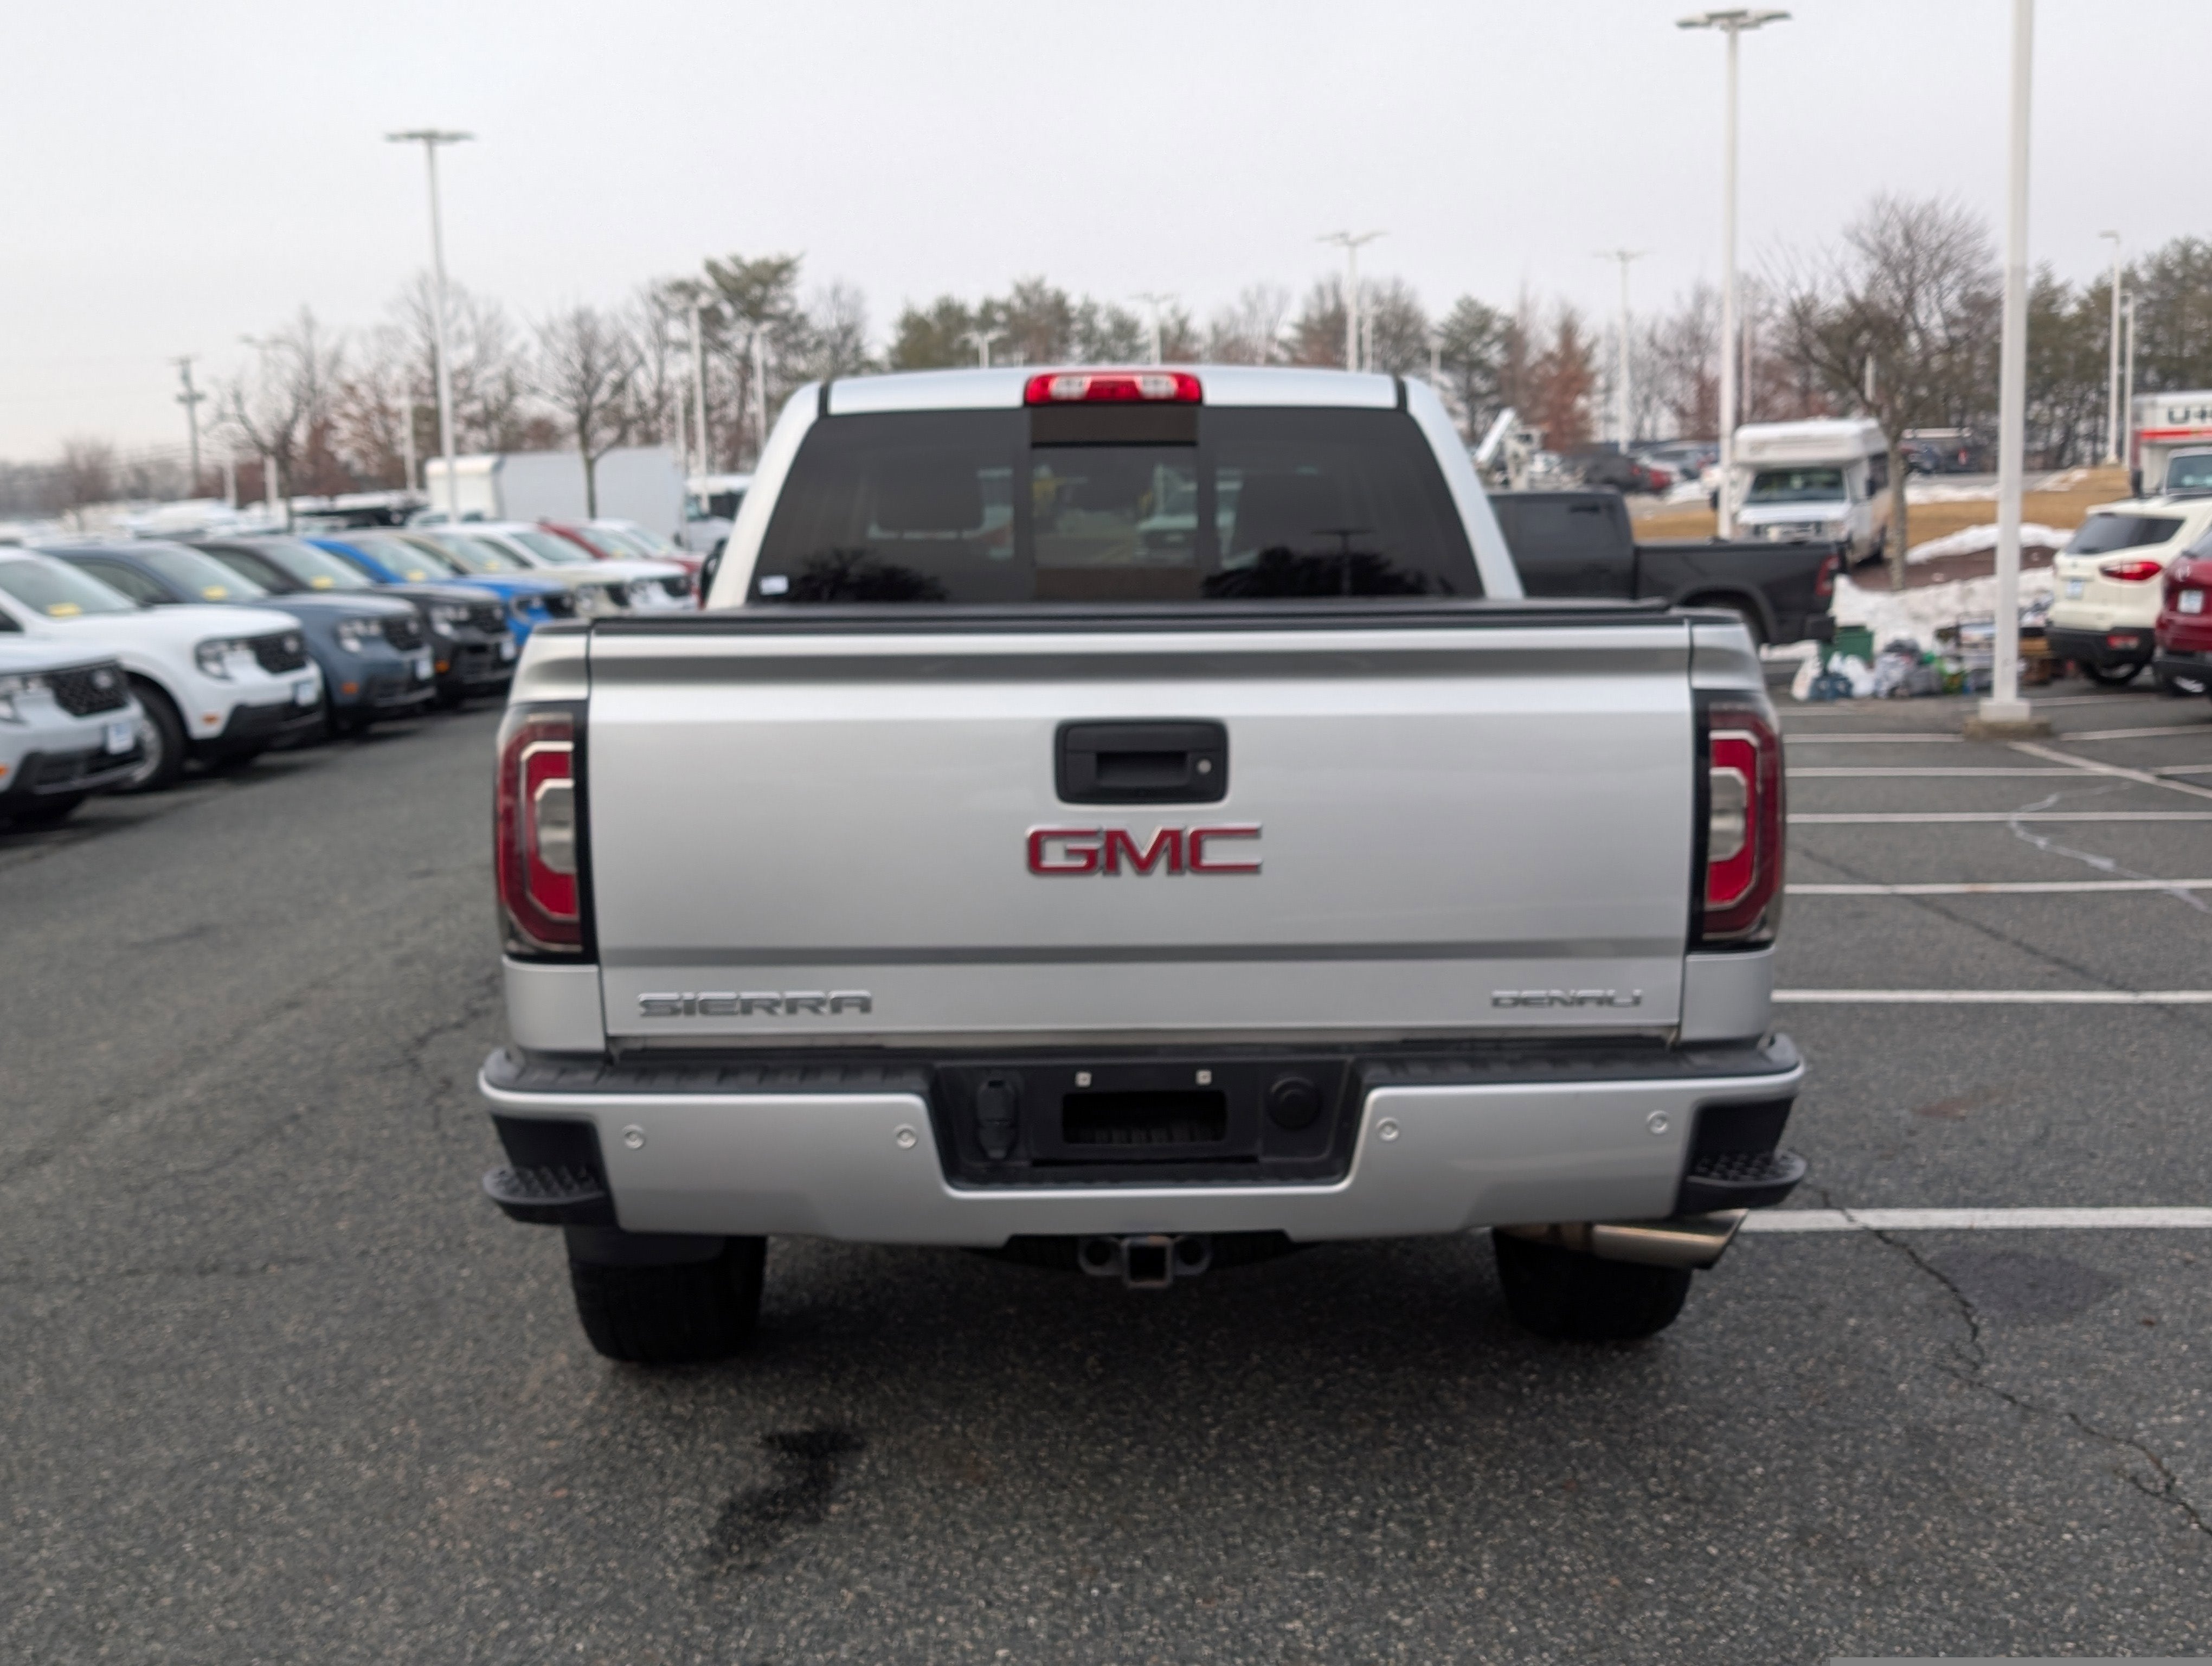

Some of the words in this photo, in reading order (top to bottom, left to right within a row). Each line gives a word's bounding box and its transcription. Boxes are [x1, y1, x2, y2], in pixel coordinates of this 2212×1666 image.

[1026, 822, 1262, 875] GMC
[638, 990, 872, 1016] SIERRA
[1491, 989, 1643, 1007] DENALI
